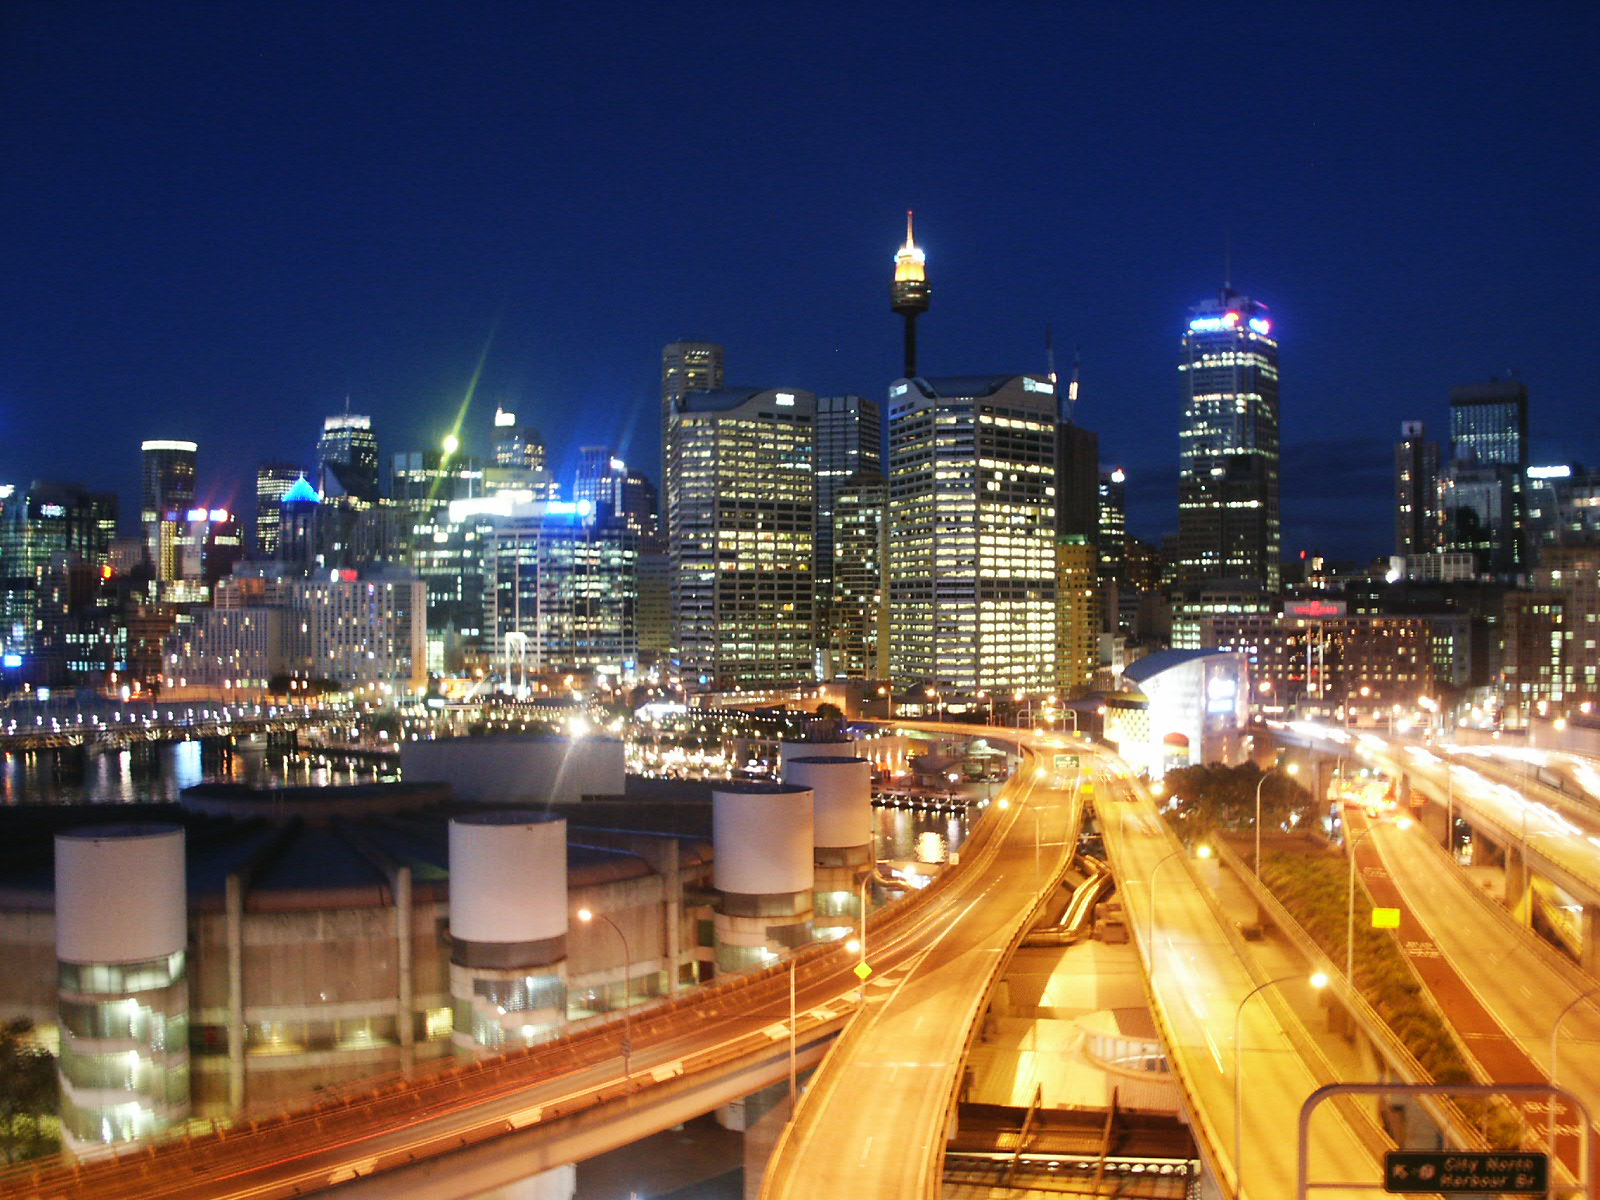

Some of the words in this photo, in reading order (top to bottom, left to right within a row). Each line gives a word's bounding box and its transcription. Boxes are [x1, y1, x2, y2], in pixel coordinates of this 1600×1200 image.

[1444, 1157, 1479, 1173] City
[1486, 1157, 1534, 1172] North
[1440, 1174, 1508, 1188] Harbour
